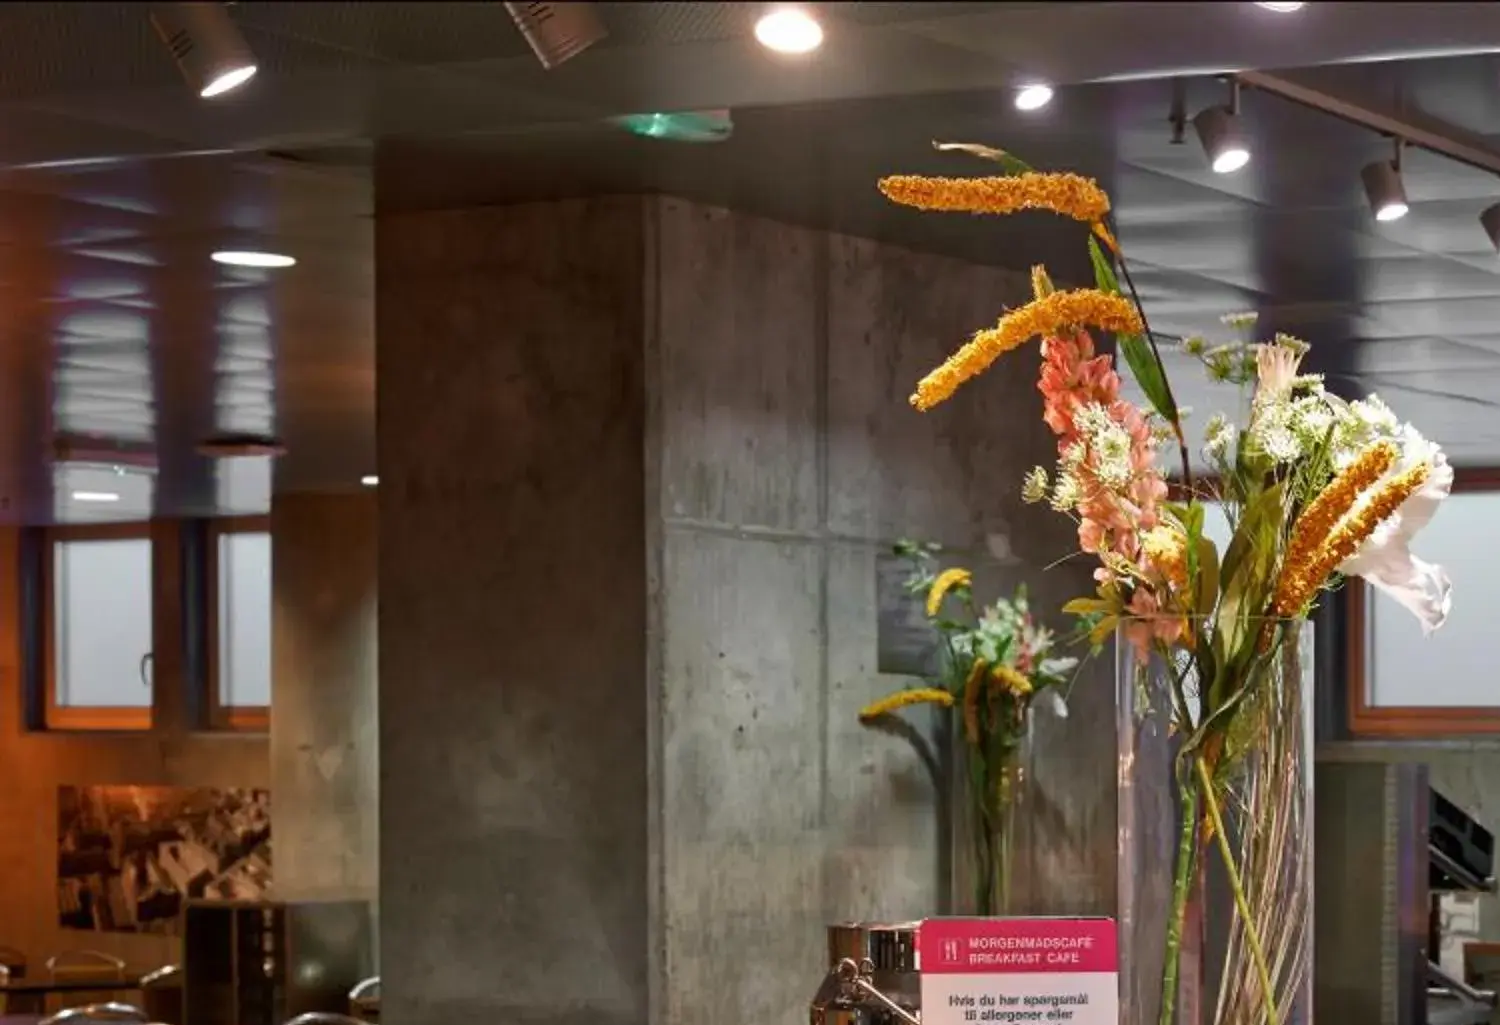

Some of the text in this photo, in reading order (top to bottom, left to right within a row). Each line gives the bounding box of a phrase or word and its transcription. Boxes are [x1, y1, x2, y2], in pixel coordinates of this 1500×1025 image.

[949, 995, 975, 1006] Hvis
[980, 994, 995, 1006] du
[1000, 994, 1019, 1006] har
[965, 1009, 977, 1020] til
[1047, 1009, 1073, 1020] eller
